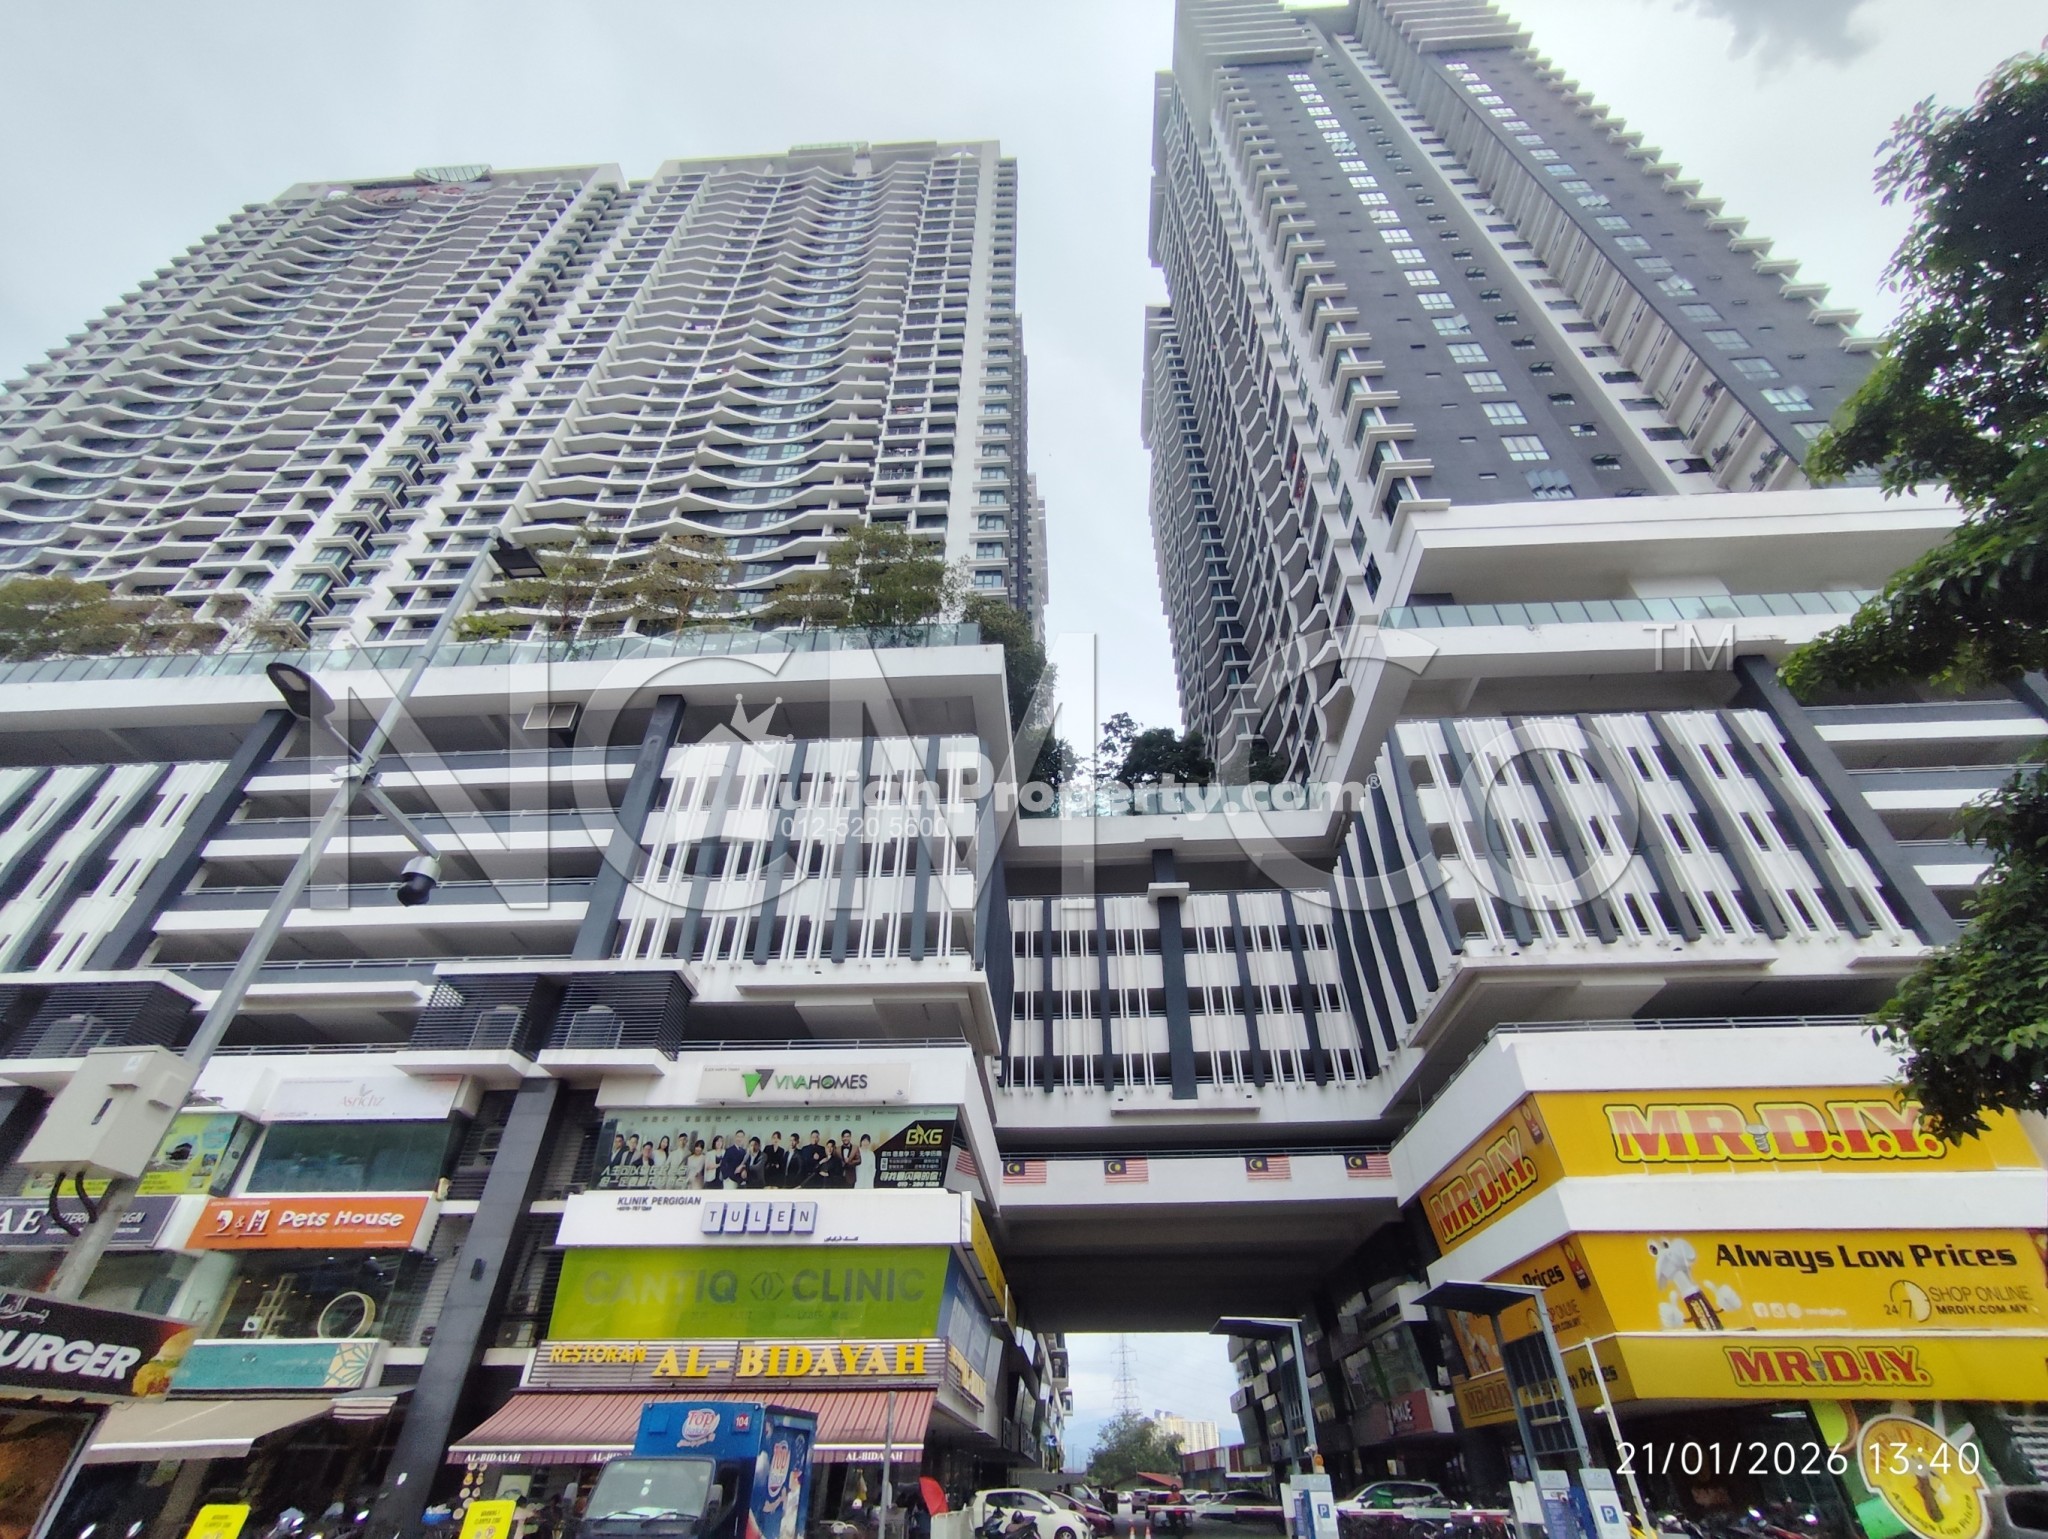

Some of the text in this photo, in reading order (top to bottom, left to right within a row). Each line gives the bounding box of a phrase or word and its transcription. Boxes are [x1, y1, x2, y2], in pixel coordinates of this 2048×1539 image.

[774, 1074, 868, 1090] VIVAHOMES
[906, 1128, 944, 1145] BKG
[1606, 1105, 1754, 1158] MR
[617, 1196, 702, 1206] KLINIK PERGIGIAN
[278, 1210, 331, 1228] Pets
[334, 1210, 405, 1228] House
[709, 1210, 809, 1222] TULEN
[1716, 1243, 2018, 1274] Always Low Prices
[582, 1269, 738, 1304] CANTIQ
[792, 1267, 925, 1303] CLINIC
[1929, 1286, 1972, 1302] SHOP
[1975, 1284, 2034, 1302] ONLINE
[1936, 1304, 2029, 1315] MRDIY.COM.MY
[0, 1329, 142, 1380] URGER
[549, 1344, 648, 1364] RESTORAN
[1726, 1347, 1931, 1384] MR D.I.Y.
[688, 1411, 749, 1428] Top 104
[465, 1453, 522, 1462] AL-BIDAYAH
[845, 1451, 903, 1461] AL-BIDAAH
